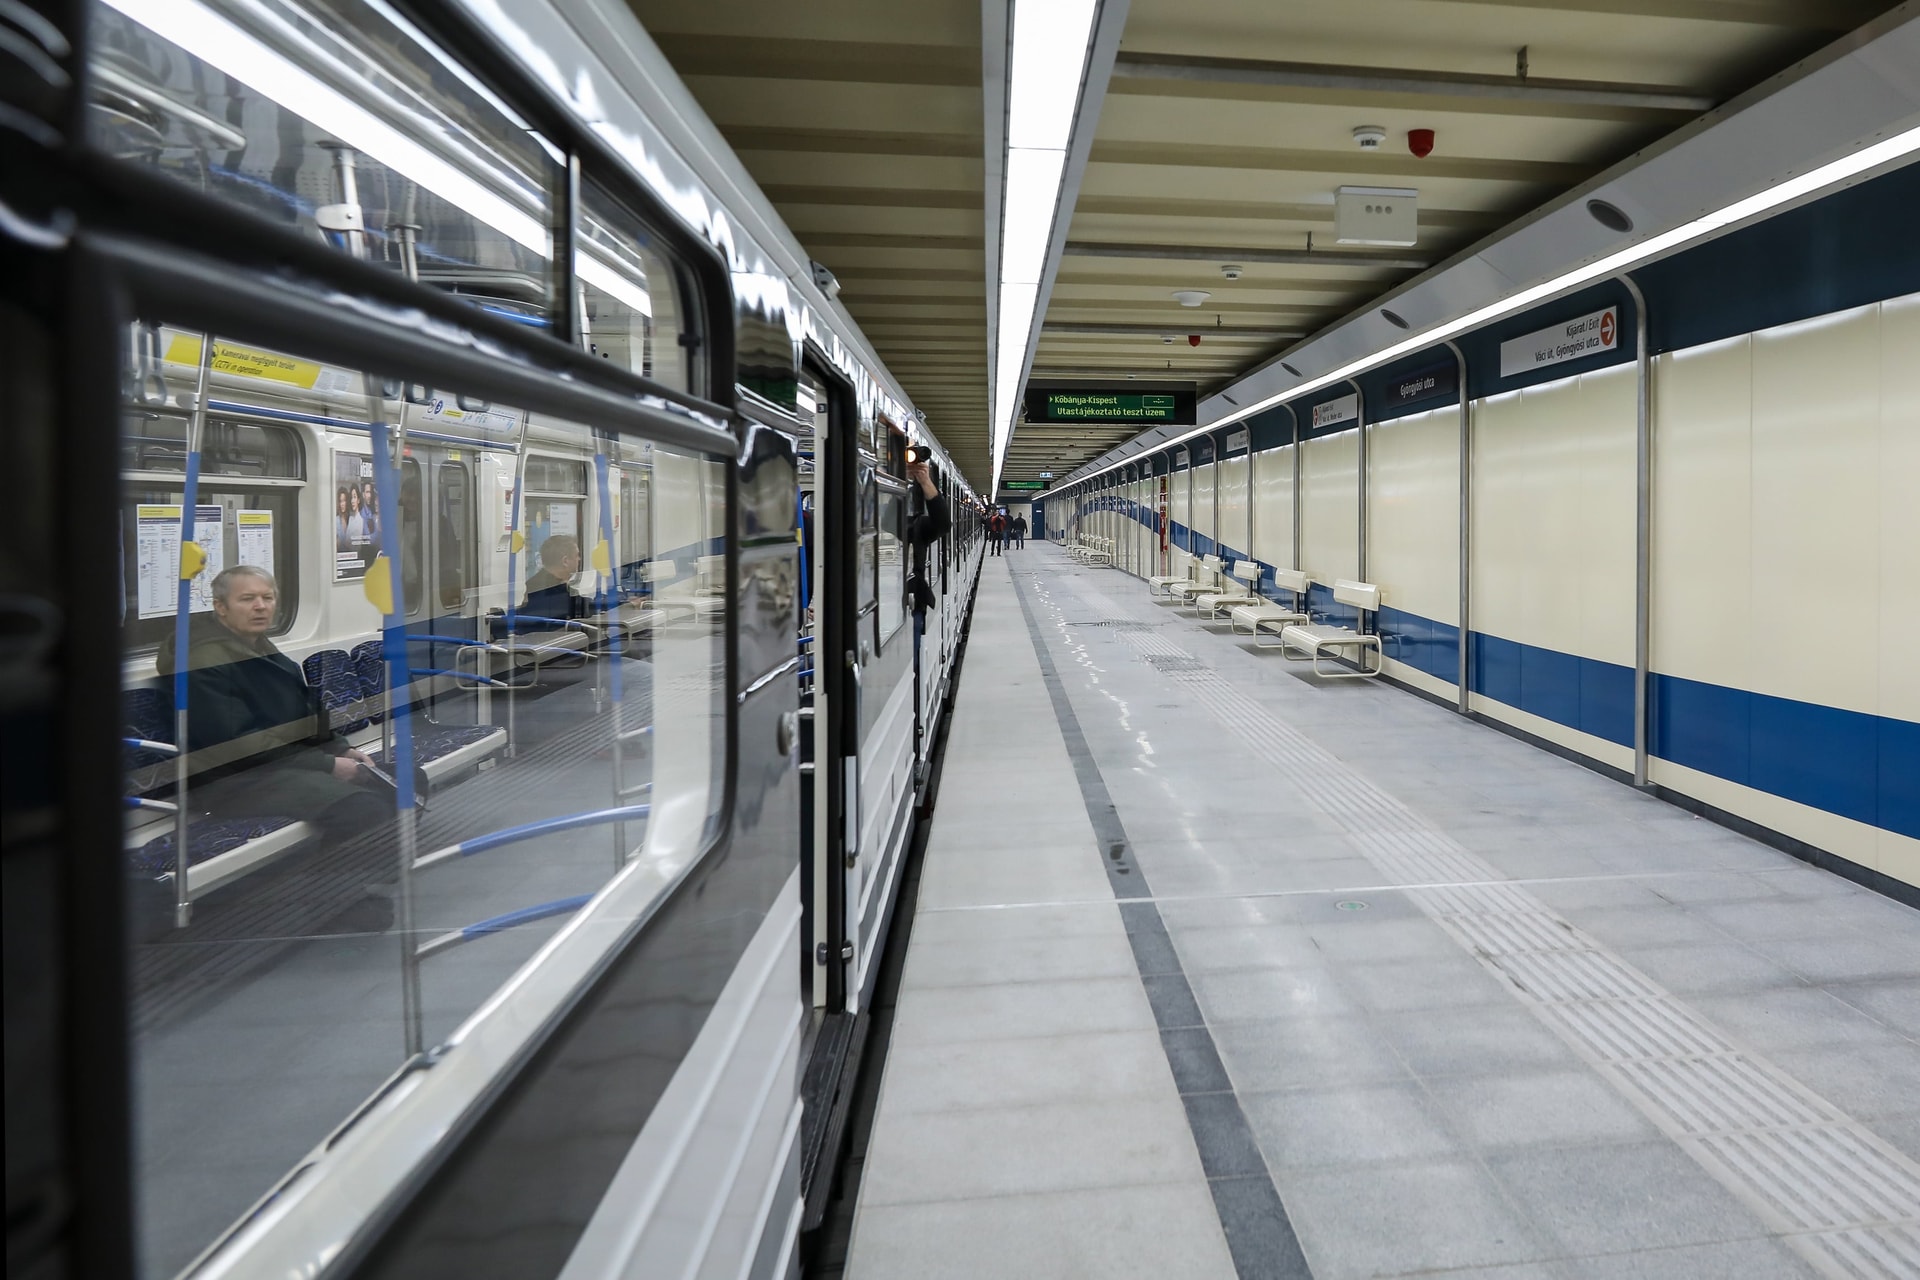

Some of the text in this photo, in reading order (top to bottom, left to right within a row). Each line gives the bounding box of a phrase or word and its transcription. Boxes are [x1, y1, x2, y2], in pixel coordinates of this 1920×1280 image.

[1589, 318, 1600, 331] Exit
[1556, 338, 1585, 358] Gyöngyösi
[1586, 337, 1600, 348] utca
[215, 359, 231, 369] CCTV
[236, 365, 263, 375] operation
[1400, 377, 1435, 399] Gyöngyösi utca
[1054, 395, 1118, 406] Kőbánya-Kispest
[1057, 407, 1166, 417] Utastájékoztató teszt üzem
